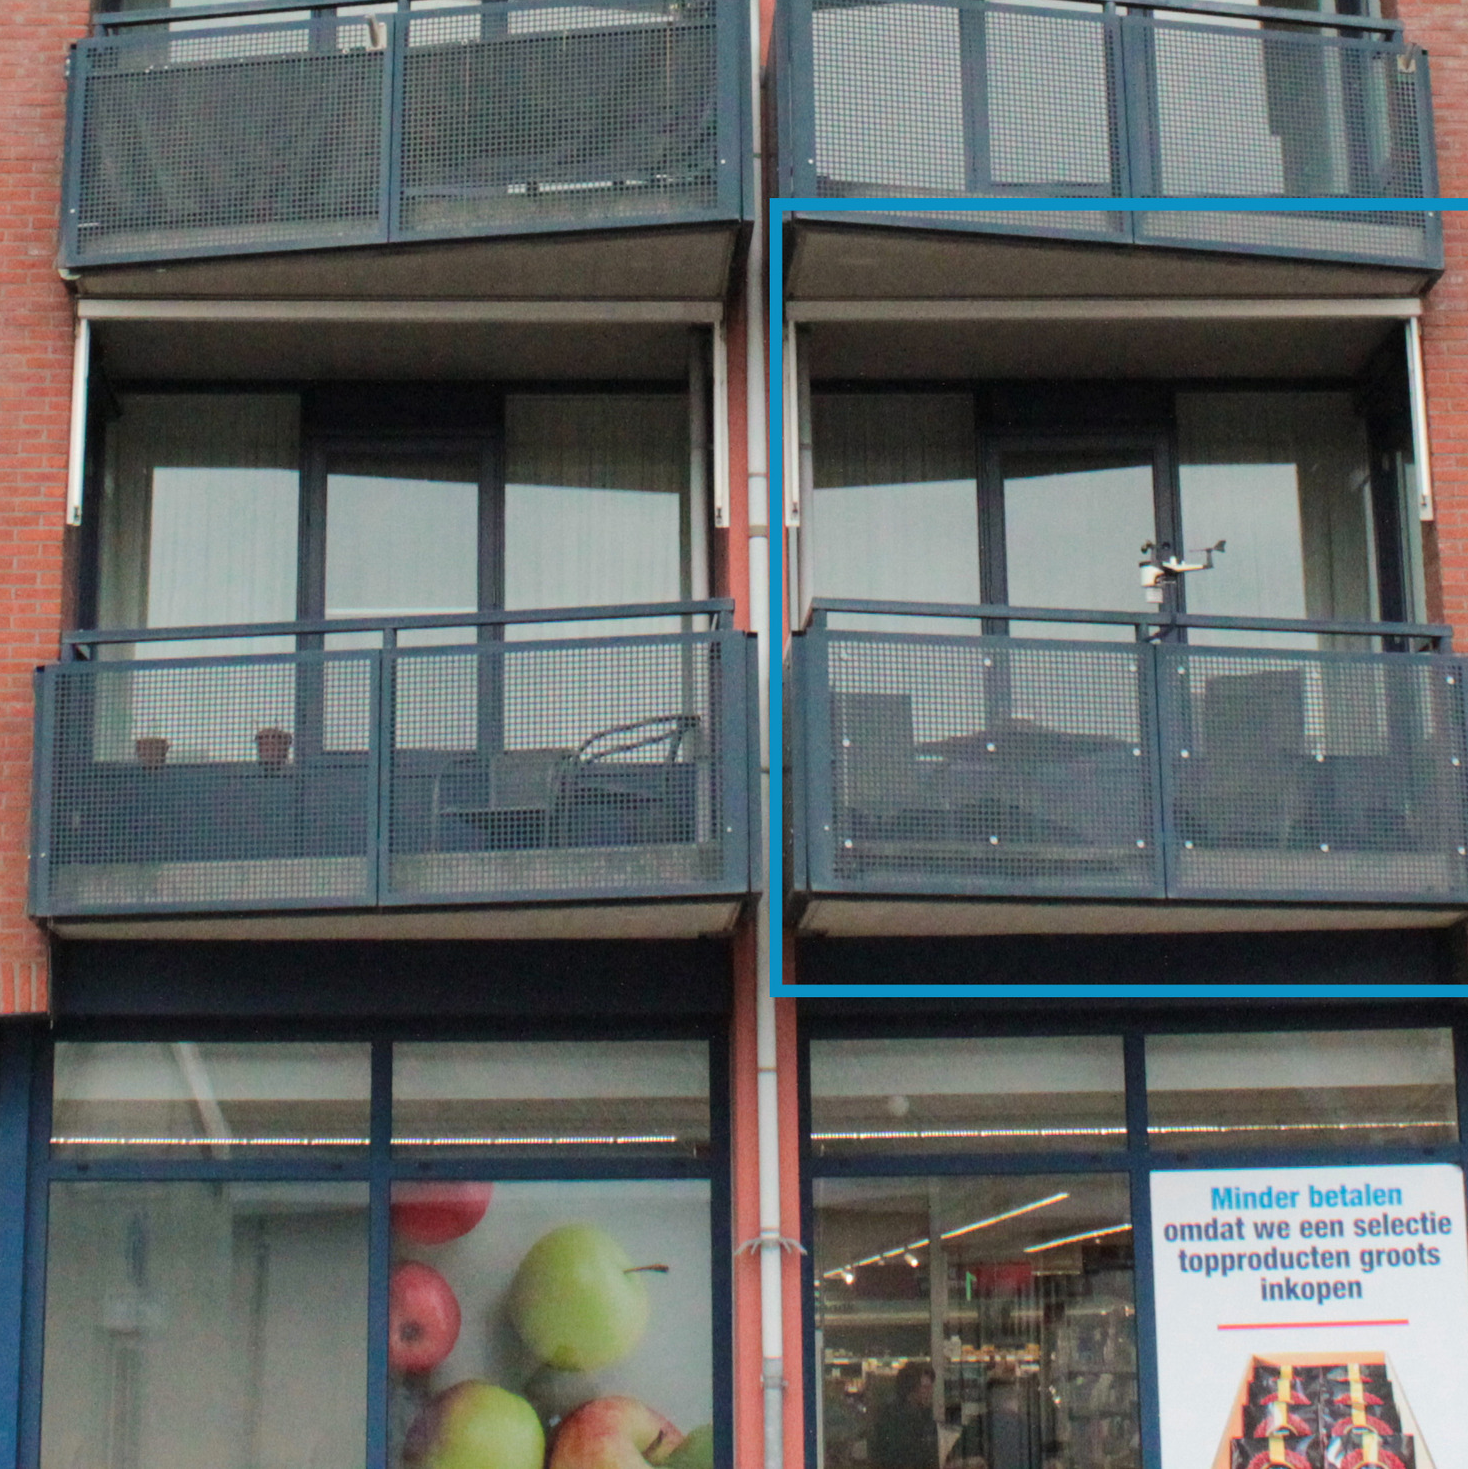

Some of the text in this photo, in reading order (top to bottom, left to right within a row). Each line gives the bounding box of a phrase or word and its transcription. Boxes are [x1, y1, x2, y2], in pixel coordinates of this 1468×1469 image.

[1211, 1183, 1403, 1211] Minder betalen
[1163, 1211, 1452, 1242] omdat we een selectie
[1178, 1242, 1442, 1277] topproducten groots
[1260, 1277, 1364, 1306] inkopen
